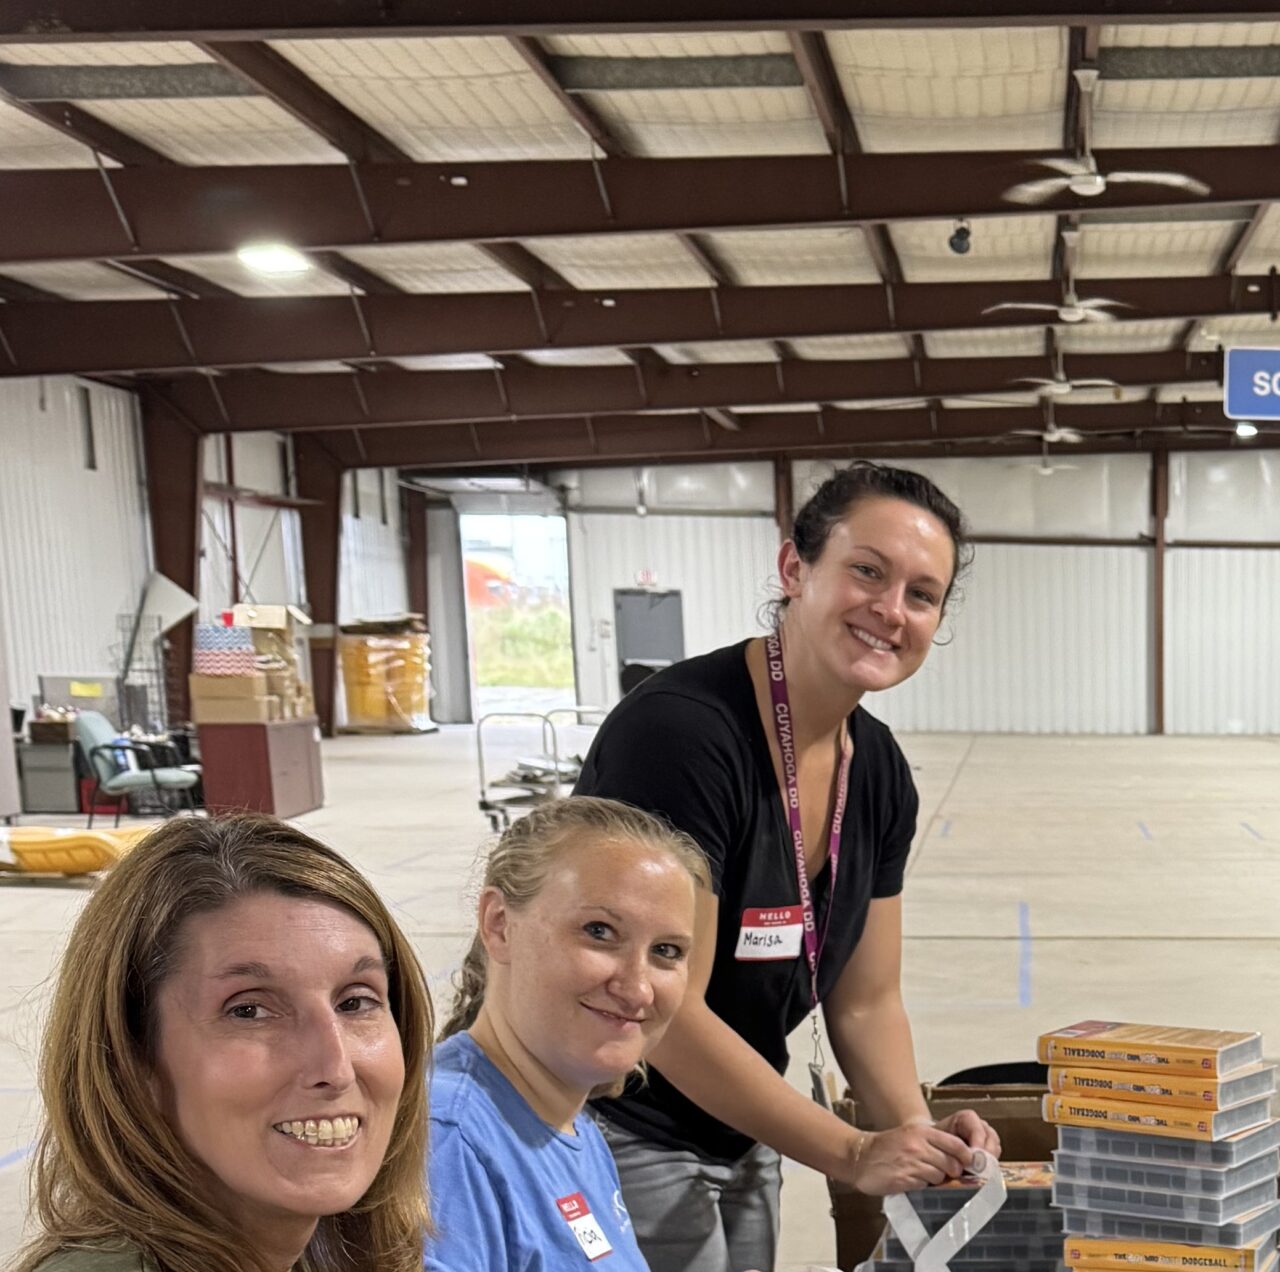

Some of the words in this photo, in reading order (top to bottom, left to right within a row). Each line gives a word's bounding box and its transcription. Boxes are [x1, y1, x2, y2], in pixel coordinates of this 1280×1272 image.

[775, 702, 797, 785] CUYAHOGA
[788, 787, 798, 808] DD
[759, 911, 791, 920] HELLO
[803, 911, 814, 932] DD
[1181, 1257, 1228, 1268] DODGEBALL
